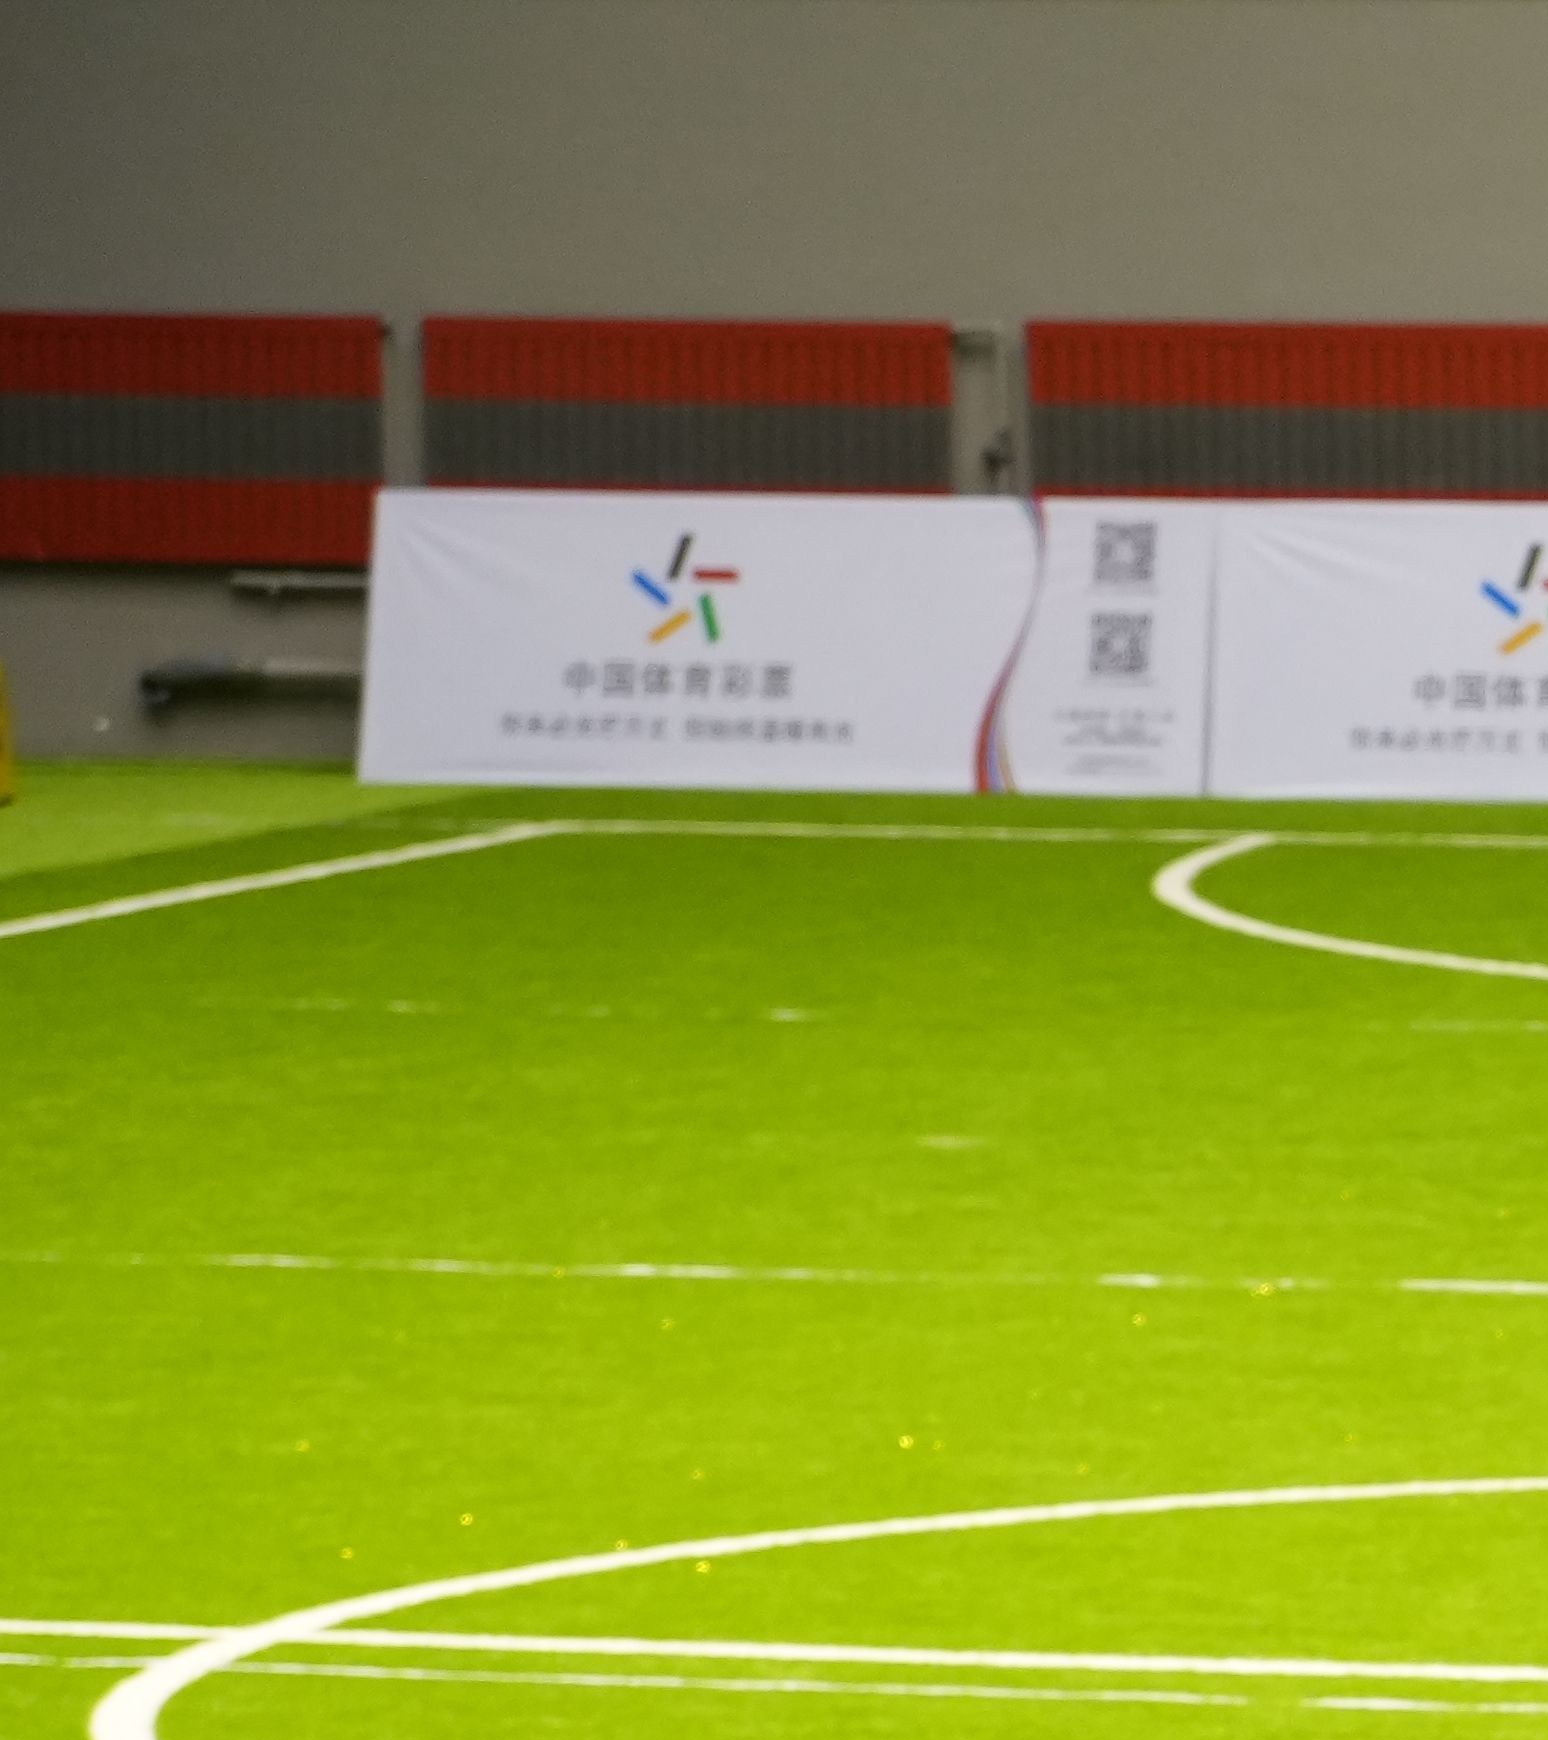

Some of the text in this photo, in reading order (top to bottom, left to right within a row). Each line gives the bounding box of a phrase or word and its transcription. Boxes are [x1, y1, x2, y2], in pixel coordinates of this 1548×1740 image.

[562, 659, 793, 701] 中国体育彩票
